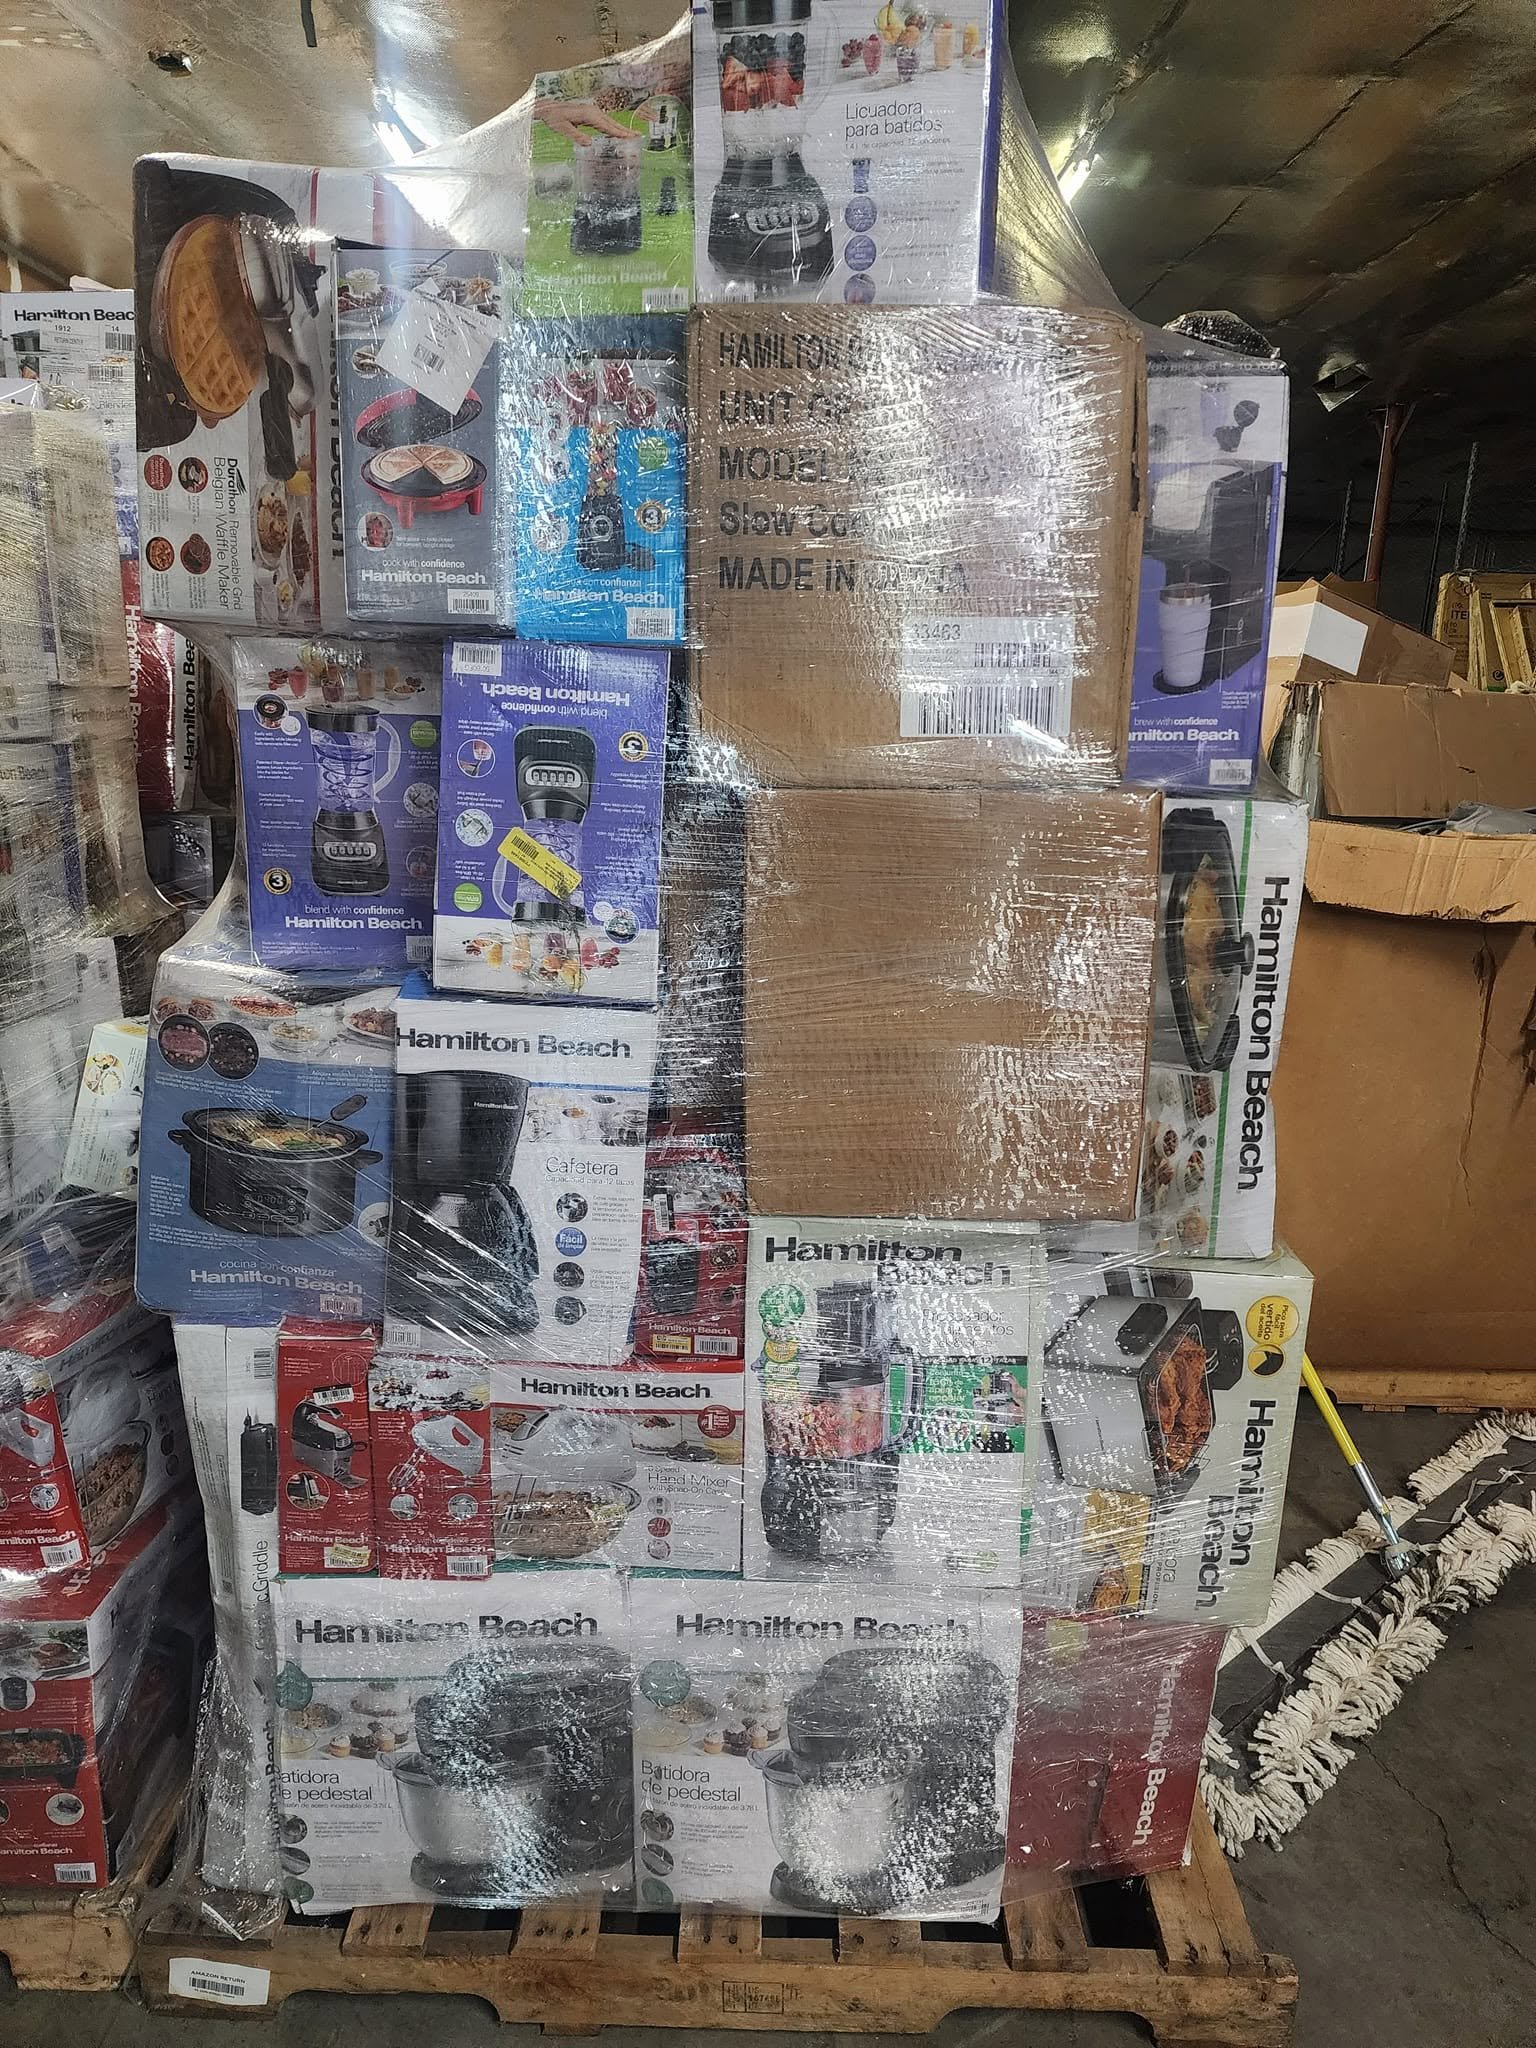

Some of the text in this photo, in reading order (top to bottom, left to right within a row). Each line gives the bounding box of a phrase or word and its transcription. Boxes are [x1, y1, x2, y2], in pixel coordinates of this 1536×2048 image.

[845, 101, 922, 120] Licuadora
[845, 116, 943, 141] para batidos
[14, 308, 136, 321] Hamilton Beac
[55, 324, 71, 332] 1912
[719, 390, 797, 424] UNIT
[719, 447, 830, 482] MODEL
[719, 501, 797, 536] Slow
[212, 457, 230, 609] Belgian Waffle Maker
[227, 458, 243, 610] Durathon Removable Grid
[404, 559, 420, 569] with
[421, 559, 465, 569] confidence
[361, 569, 486, 585] Hamilton Beach
[600, 577, 641, 588] confianza
[719, 556, 813, 591] MADE
[825, 558, 855, 592] IN
[612, 590, 664, 604] Beach
[1451, 610, 1469, 620] ITE
[183, 638, 196, 771] Hamilton Bea
[546, 686, 630, 707] Hamilton
[501, 701, 608, 720] blend with confidence
[1174, 717, 1218, 726] confidence
[1128, 729, 1240, 741] milton Beach
[270, 873, 285, 888] 3
[305, 904, 404, 916] blend with confidence
[285, 916, 423, 930] Hamilton Beach
[1236, 875, 1291, 1191] Hamilton Beach
[396, 1028, 631, 1059] Hamilton Beach
[546, 1156, 619, 1176] Cafetera
[605, 1177, 614, 1185] 12
[559, 1233, 583, 1244] Fácil
[766, 1237, 962, 1262] Hamilton
[219, 1259, 257, 1269] cocina
[281, 1264, 335, 1278] confianza
[190, 1269, 363, 1295] Hamilton Beach
[648, 1323, 731, 1335] Hamilton Beach
[1263, 1303, 1275, 1341] vertido
[520, 1377, 711, 1400] Hamilton Beach
[648, 1473, 731, 1488] Hand Mixer
[1228, 1400, 1278, 1567] Hamilton
[0, 1530, 77, 1545] milton Beach
[284, 1533, 369, 1545] Hamilton Beach
[385, 1544, 487, 1554] Hamilton Beach
[1195, 1494, 1235, 1610] Beach
[252, 1540, 270, 1592] Griddle
[296, 1612, 599, 1644] Hamilton Beach
[676, 1614, 969, 1642] Hamilton Beach
[641, 1760, 710, 1783] Batidora
[298, 1786, 373, 1805] pedestal
[667, 1785, 741, 1802] pedestal
[1132, 1767, 1167, 1846] Beach
[0, 1847, 73, 1856] amilton Beach
[191, 1970, 246, 1984] AMAZON RETURN
